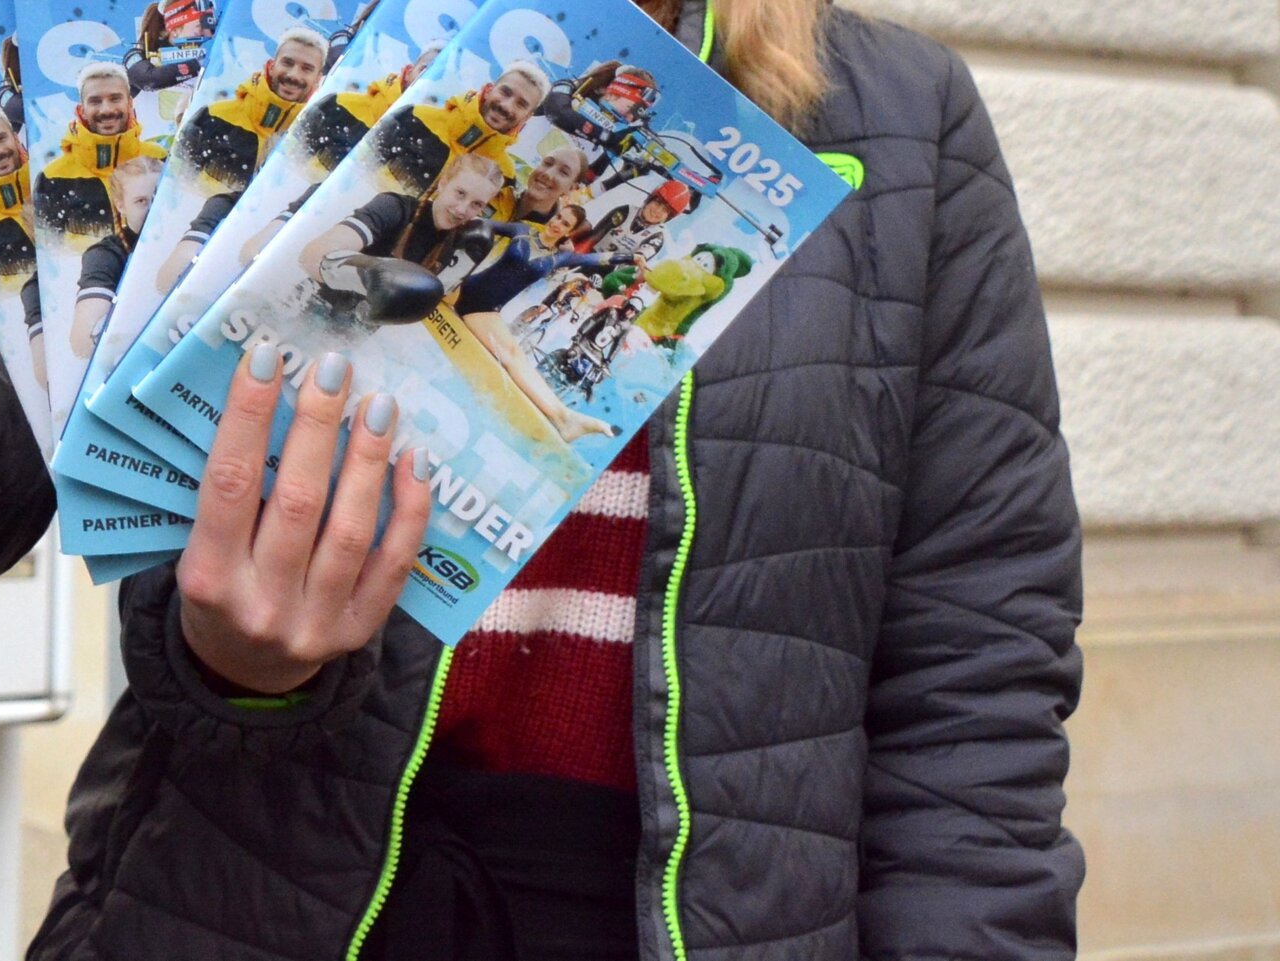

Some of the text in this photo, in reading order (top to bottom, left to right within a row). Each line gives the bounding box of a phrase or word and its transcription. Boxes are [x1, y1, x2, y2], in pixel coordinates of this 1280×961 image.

[704, 126, 804, 207] 2025
[426, 308, 461, 350] SPIETH
[85, 443, 163, 480] PARTNER
[82, 513, 162, 533] PARTNER
[417, 546, 475, 591] KSB
